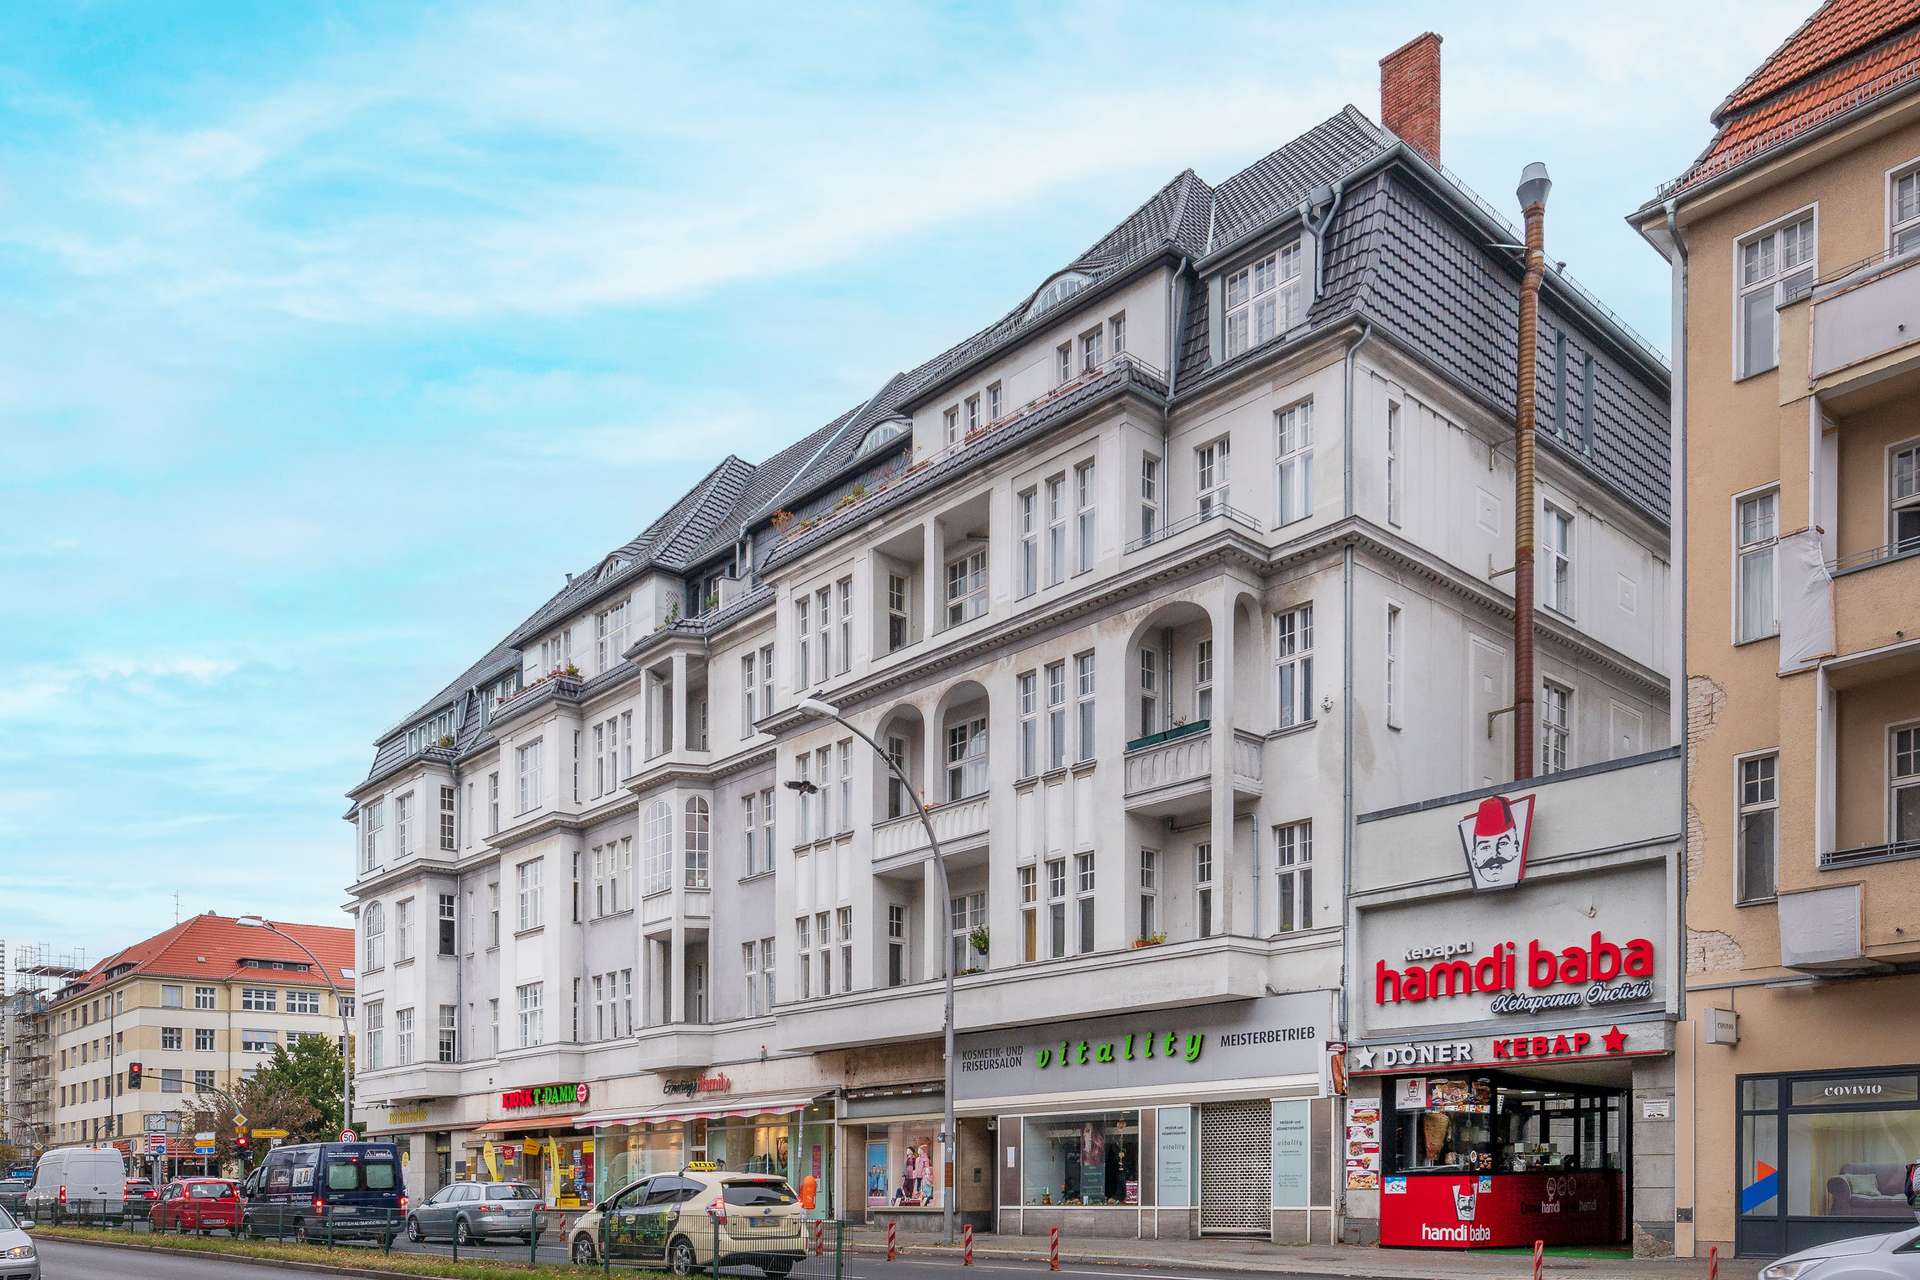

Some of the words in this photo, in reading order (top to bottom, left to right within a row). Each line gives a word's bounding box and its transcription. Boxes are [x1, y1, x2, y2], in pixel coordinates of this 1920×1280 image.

[1376, 941, 1515, 1006] hamdi
[1528, 931, 1654, 989] baba
[1220, 1026, 1316, 1048] MEISTERBETRIEB
[962, 1046, 1003, 1061] KOSMETIK-
[1006, 1045, 1024, 1056] UND
[1037, 1031, 1204, 1069] vitality
[1383, 1042, 1473, 1066] DÖNER
[1493, 1032, 1590, 1058] KEBAP
[962, 1056, 1022, 1072] FRISEURSALON
[502, 1088, 533, 1109] KIOSK
[1824, 1084, 1882, 1097] COVIVIO
[343, 1133, 354, 1143] 50
[1422, 1223, 1468, 1241] hamdi
[1469, 1224, 1491, 1241] baba
